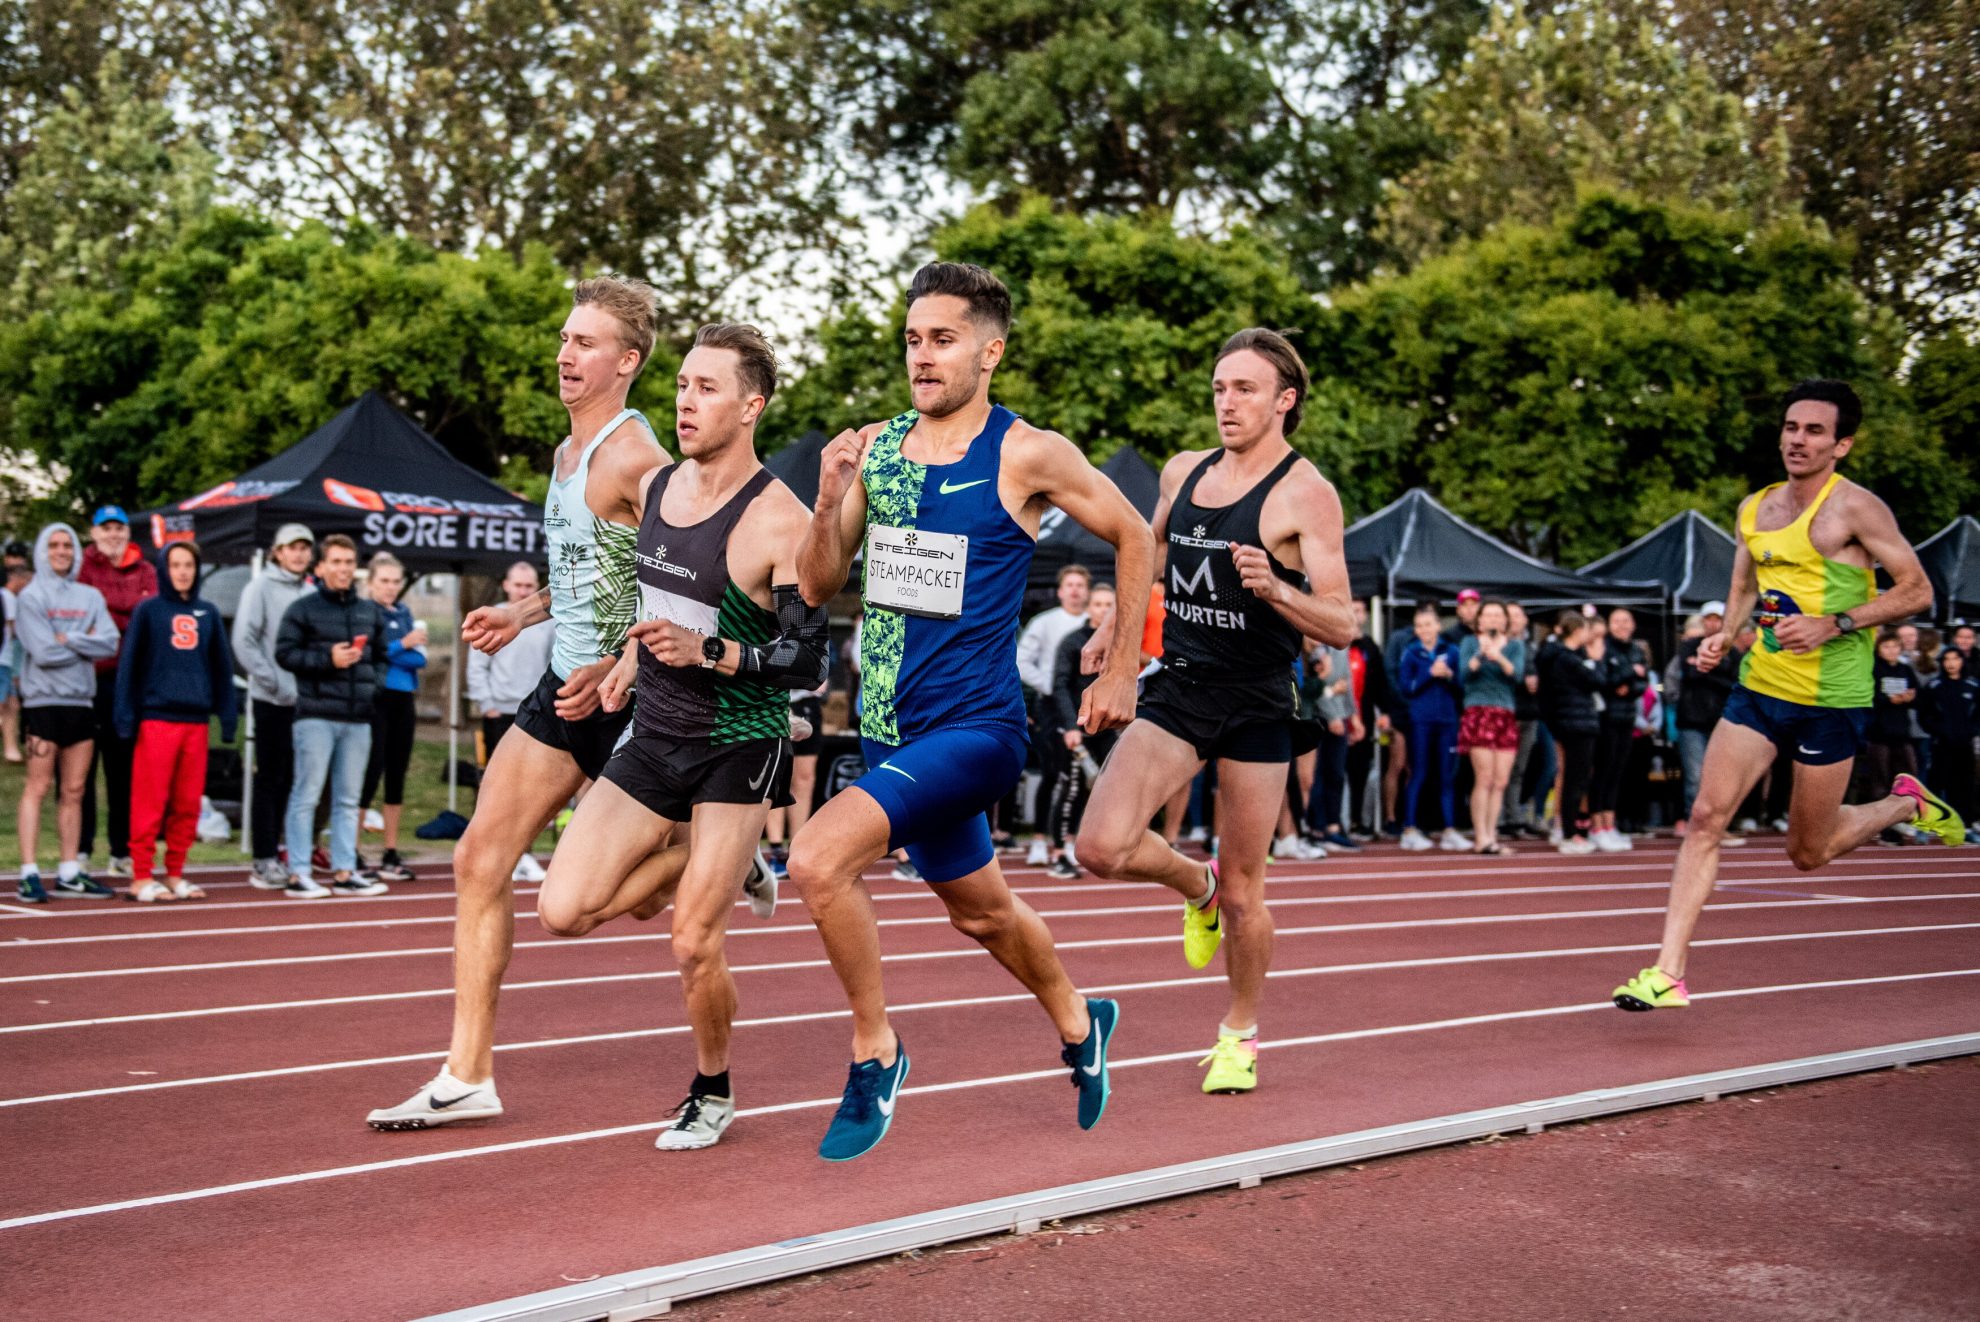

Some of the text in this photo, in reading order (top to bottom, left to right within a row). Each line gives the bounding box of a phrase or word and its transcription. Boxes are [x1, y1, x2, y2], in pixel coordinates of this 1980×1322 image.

[363, 513, 549, 553] SORE FEET
[1170, 532, 1231, 549] STEIGEN
[874, 542, 954, 560] STEIGEN
[870, 560, 962, 588] STEAMPACKET
[897, 587, 918, 598] FOODS
[171, 614, 198, 650] S
